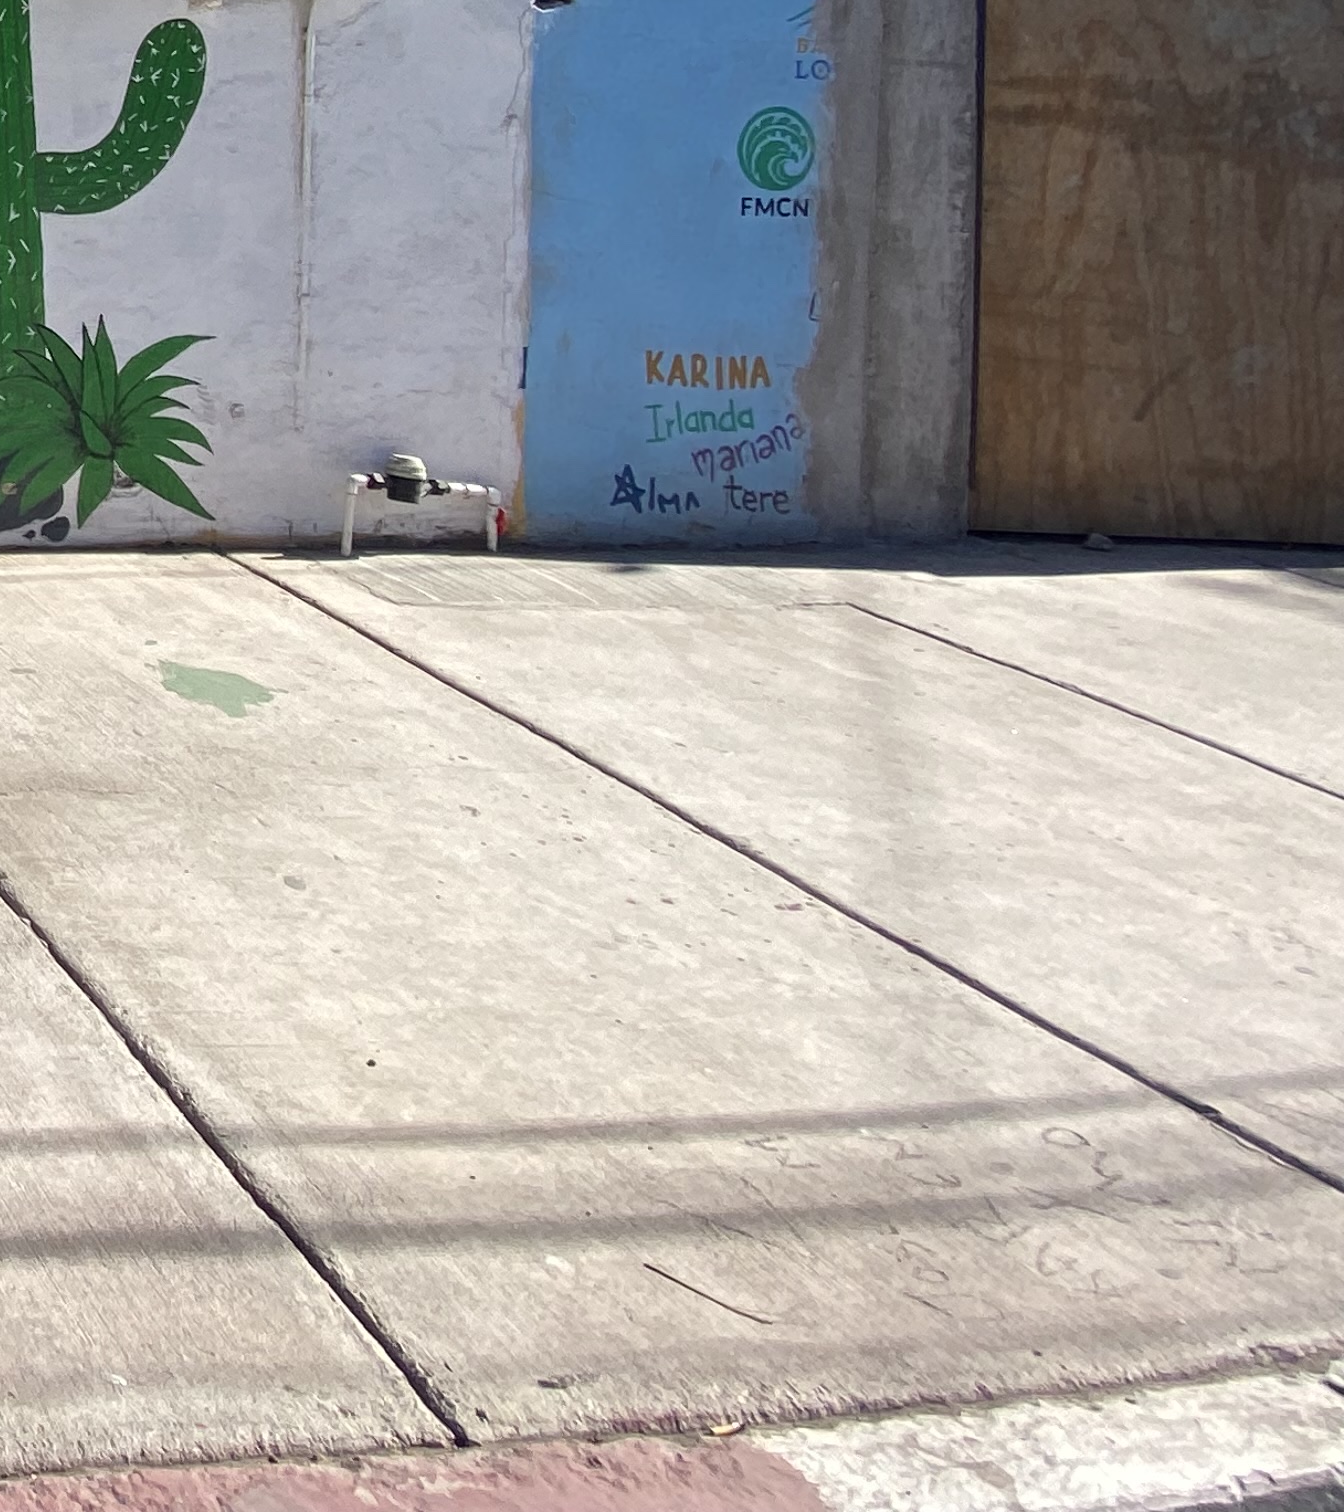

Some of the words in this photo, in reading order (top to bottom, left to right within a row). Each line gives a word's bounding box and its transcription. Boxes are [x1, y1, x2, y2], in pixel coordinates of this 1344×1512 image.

[741, 197, 809, 217] FMCN
[645, 350, 771, 390] KARINA
[643, 399, 754, 443] Irlanda
[691, 413, 805, 483] mariana
[723, 475, 790, 514] tere
